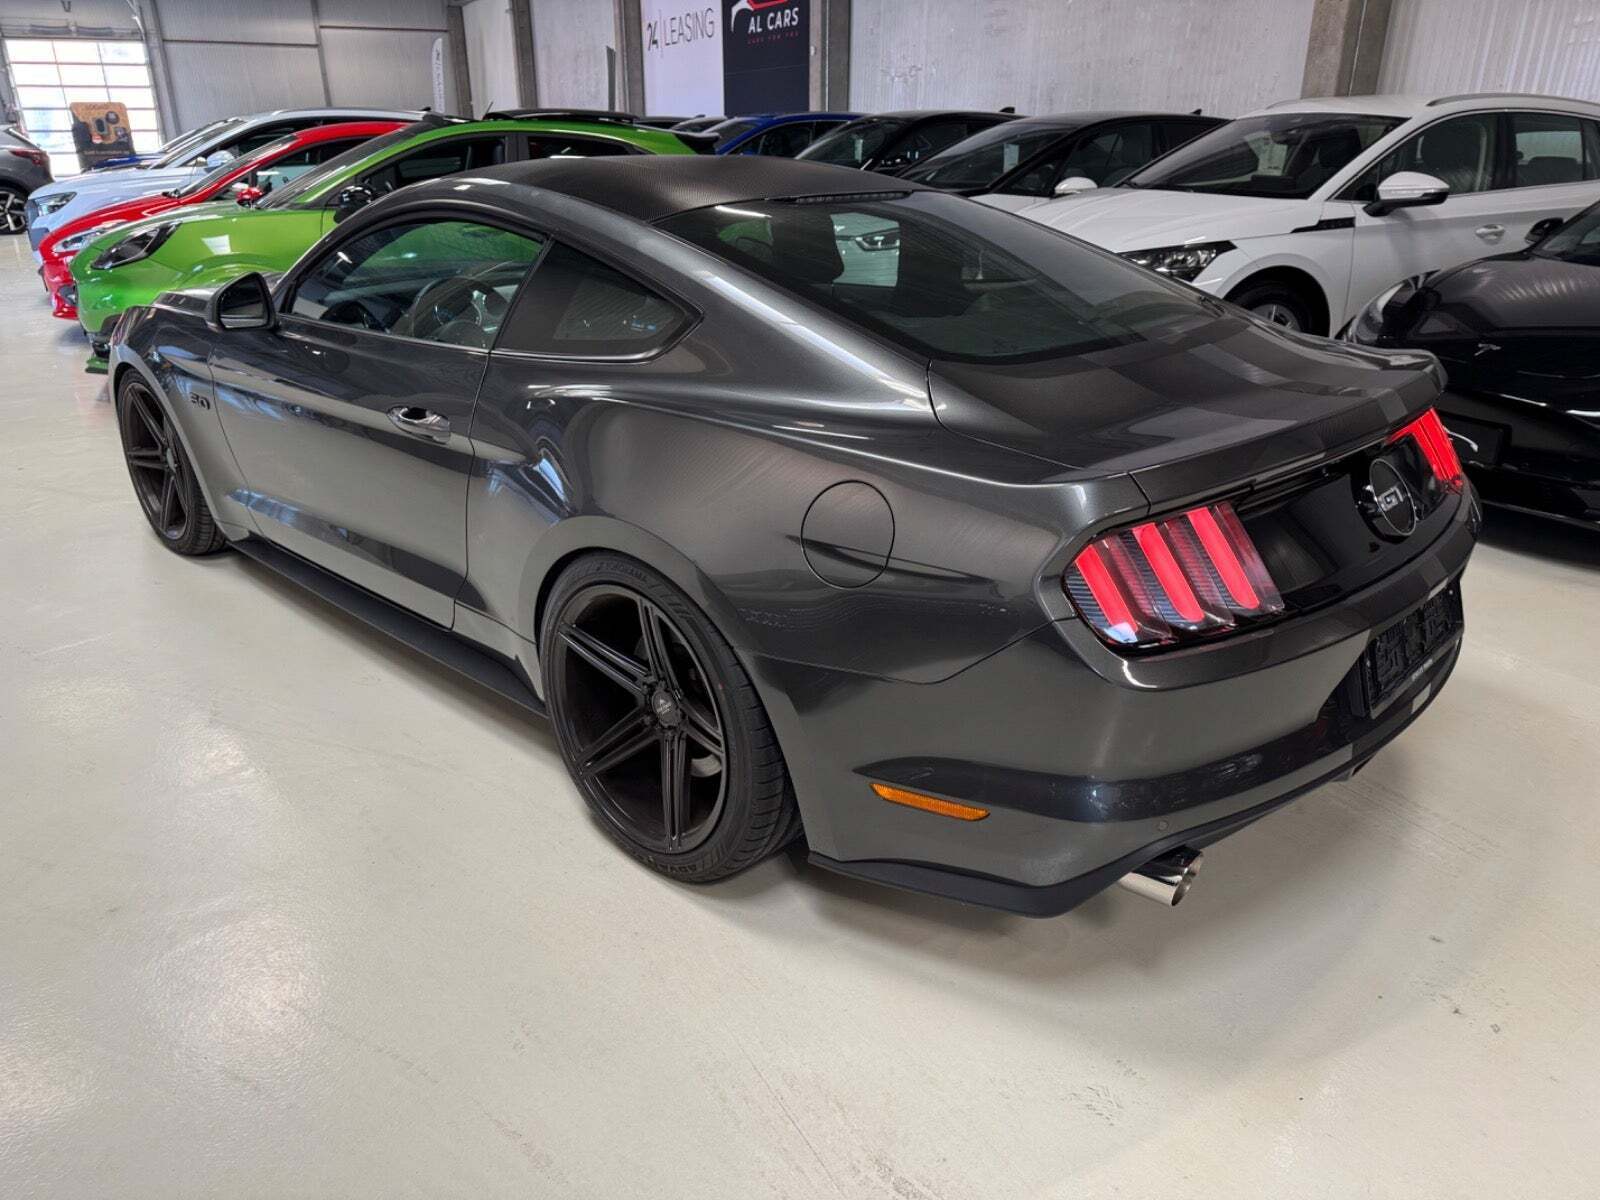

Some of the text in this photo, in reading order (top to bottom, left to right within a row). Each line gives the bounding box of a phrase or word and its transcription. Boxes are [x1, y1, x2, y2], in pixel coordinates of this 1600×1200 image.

[664, 8, 714, 46] LEASING
[748, 7, 799, 34] AL CARS
